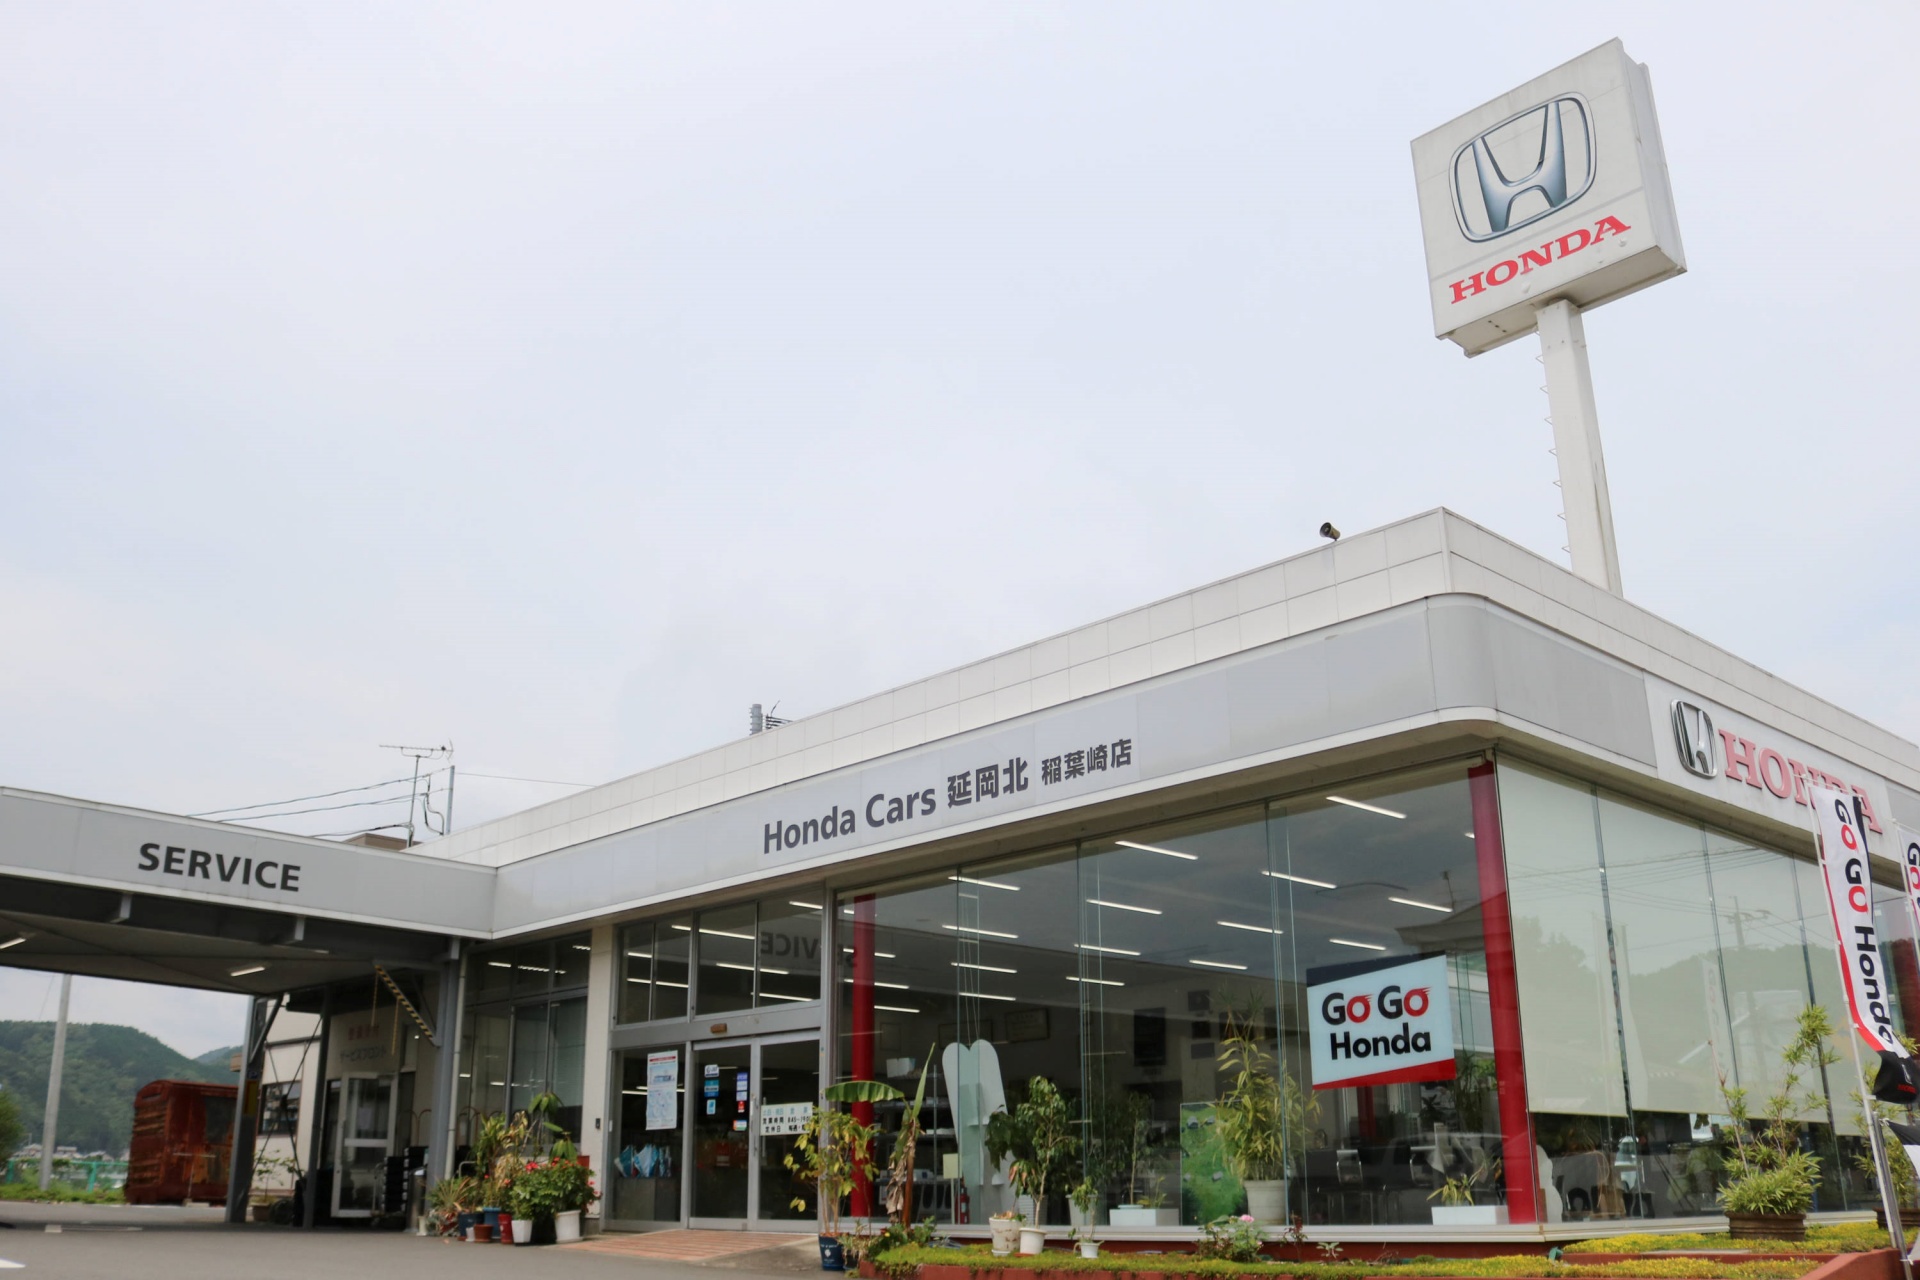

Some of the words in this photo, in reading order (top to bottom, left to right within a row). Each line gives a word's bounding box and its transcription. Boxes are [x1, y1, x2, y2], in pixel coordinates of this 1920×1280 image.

[1449, 215, 1631, 304] HONDA
[763, 805, 856, 854] Honda
[865, 788, 937, 828] Cars
[947, 756, 1029, 809] 延岡北
[1041, 738, 1133, 786] 稲葉崎店
[138, 842, 302, 893] SERVICE
[1321, 991, 1373, 1026] Go
[1377, 984, 1432, 1020] Go
[1329, 1021, 1432, 1061] Honda
